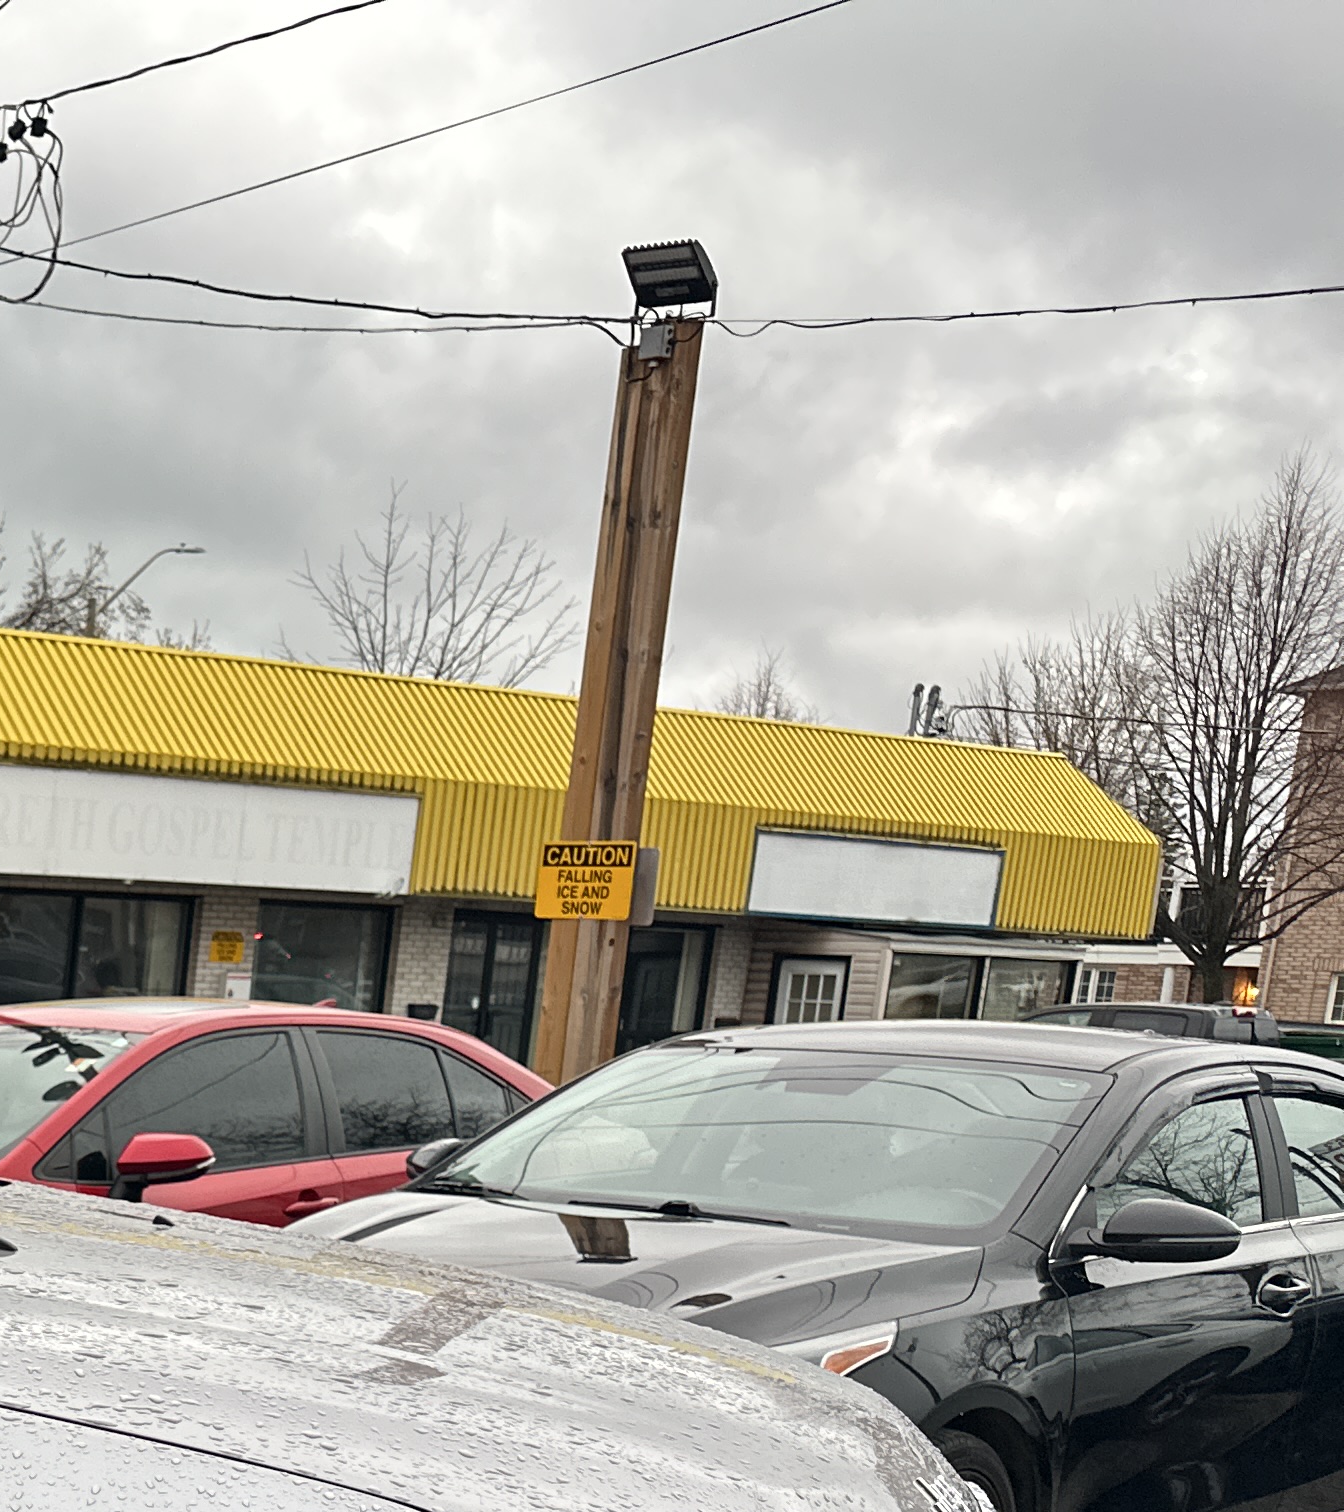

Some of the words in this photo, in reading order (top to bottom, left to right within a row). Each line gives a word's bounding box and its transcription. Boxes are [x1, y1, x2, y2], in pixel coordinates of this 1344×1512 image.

[107, 800, 256, 862] GOSPEL
[263, 812, 411, 872] TEMPLE
[546, 846, 630, 866] CAUTION
[557, 869, 612, 884] FALLING
[556, 885, 579, 899] ICE
[581, 885, 610, 900] AND
[561, 900, 603, 916] SNOW
